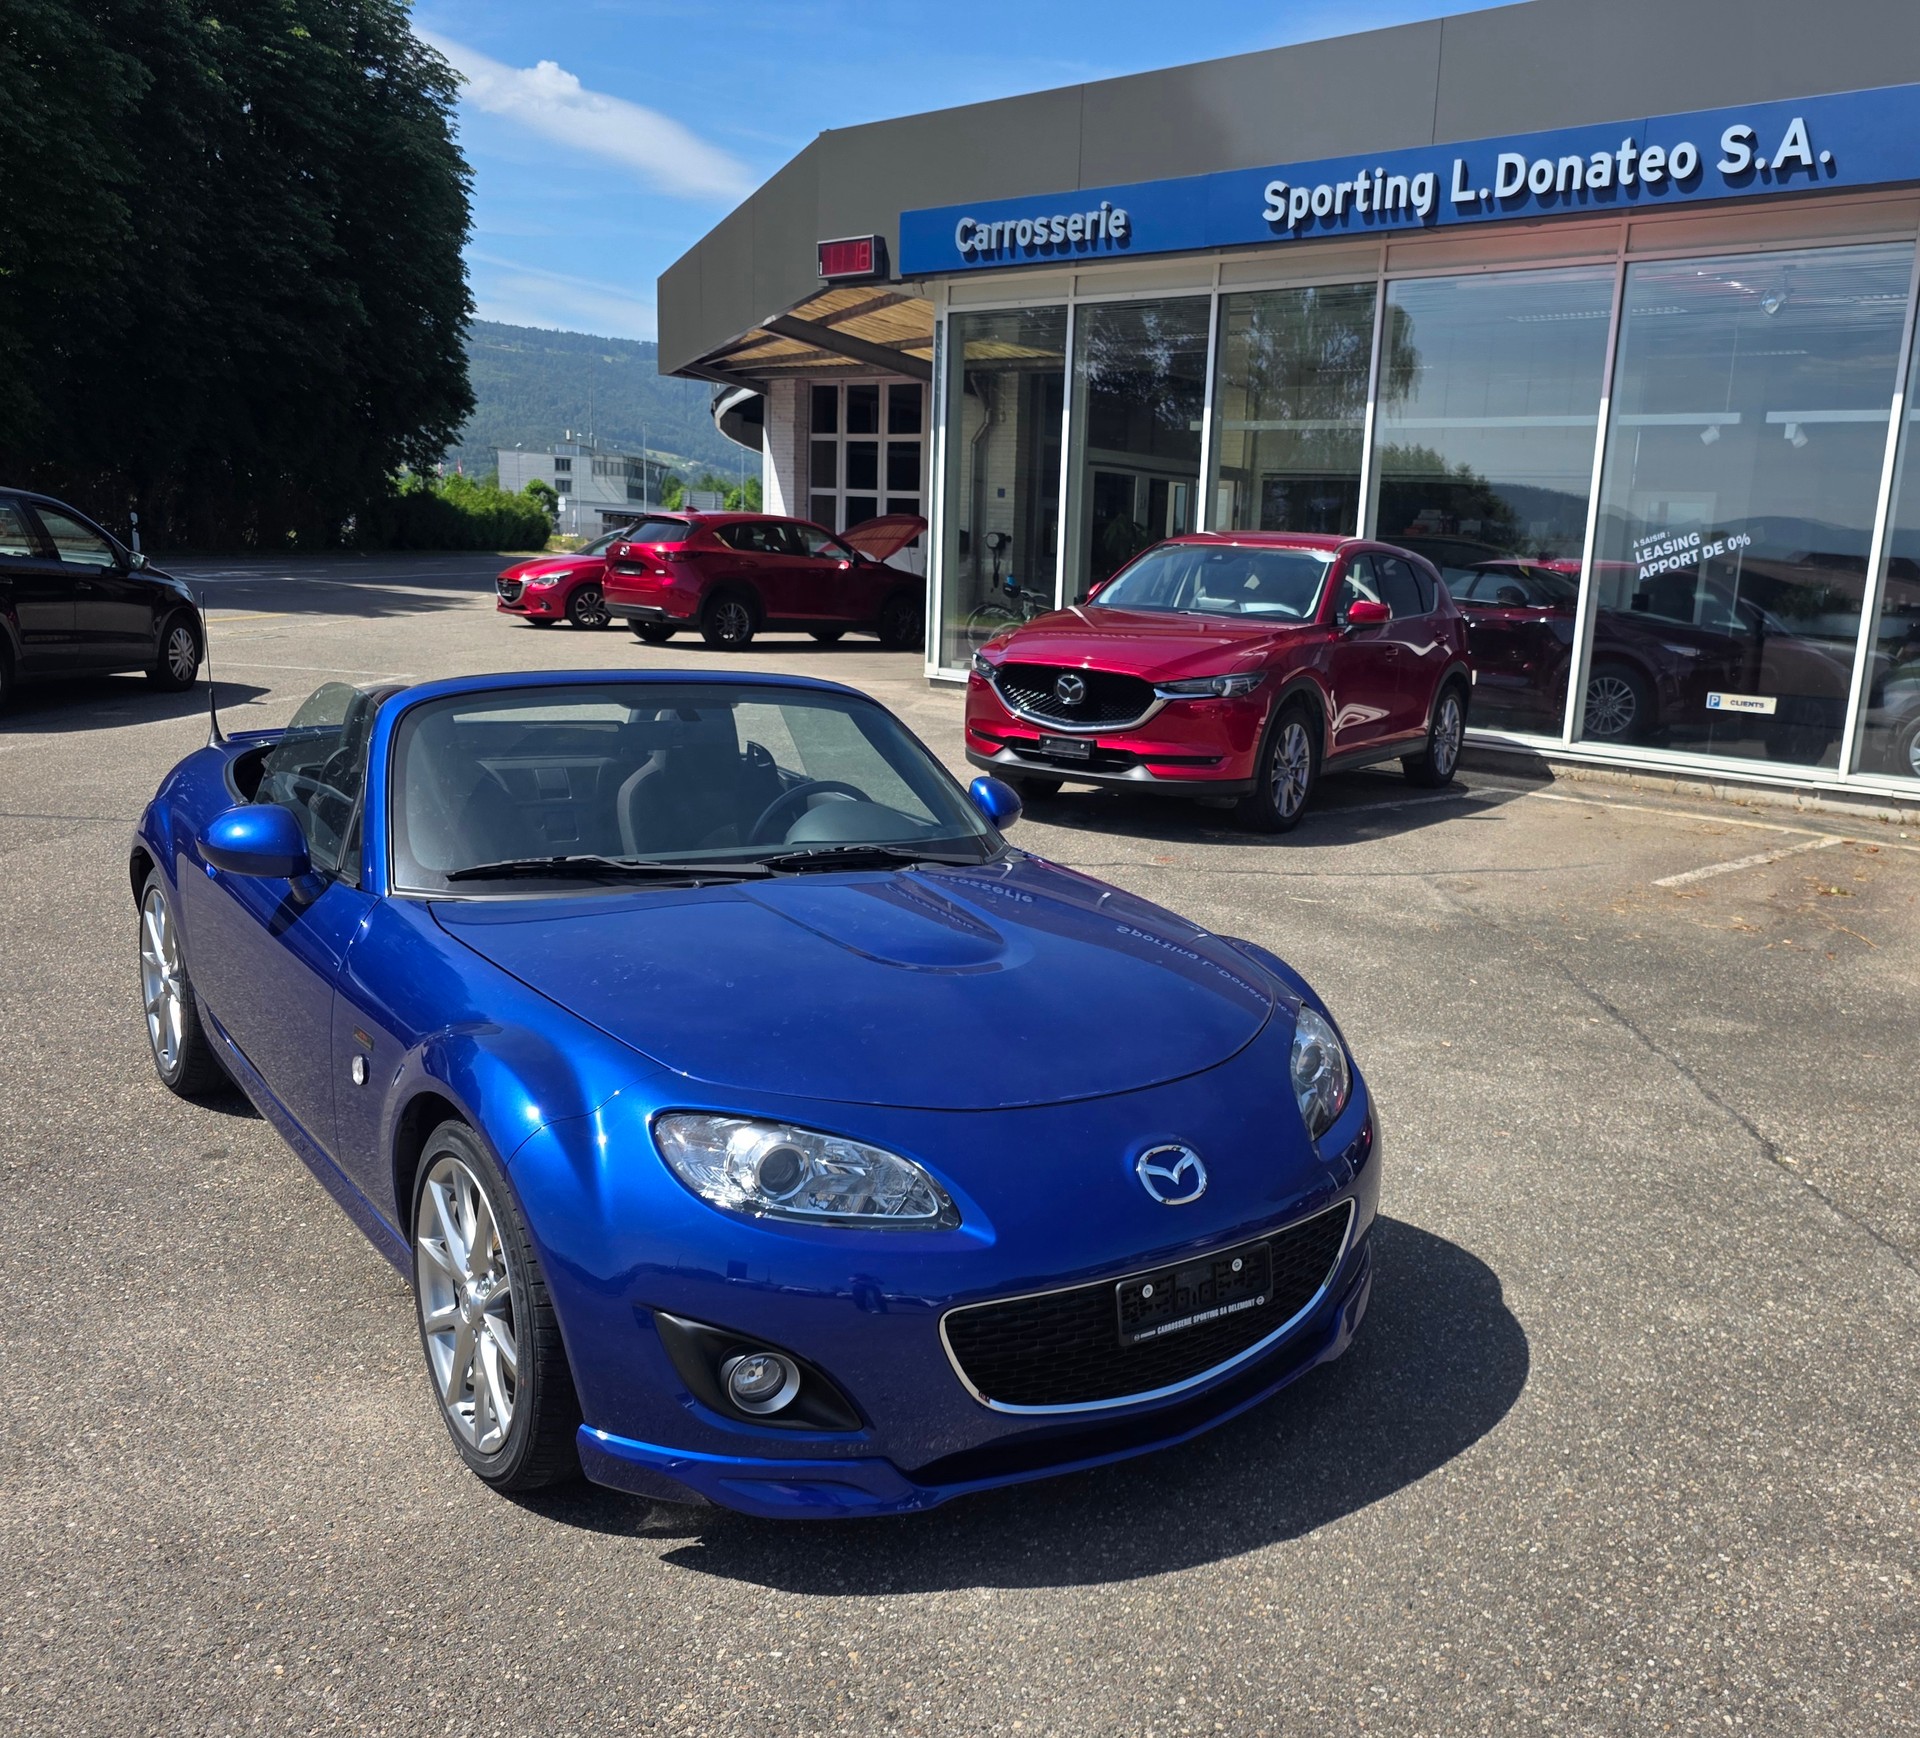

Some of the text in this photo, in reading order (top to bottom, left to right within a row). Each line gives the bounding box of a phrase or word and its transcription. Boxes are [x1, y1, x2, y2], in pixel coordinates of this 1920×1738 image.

[1263, 117, 1831, 229] Sporting L.Donateo S.A.
[955, 201, 1128, 253] Carrosserie
[1635, 532, 1700, 564] LEASING
[1640, 532, 1666, 547] SAISIR
[1639, 532, 1751, 580] APPORT DE 0%
[1710, 696, 1764, 708] P CLIENTS
[1193, 1308, 1219, 1323] SPORTING
[1220, 1306, 1228, 1315] SA
